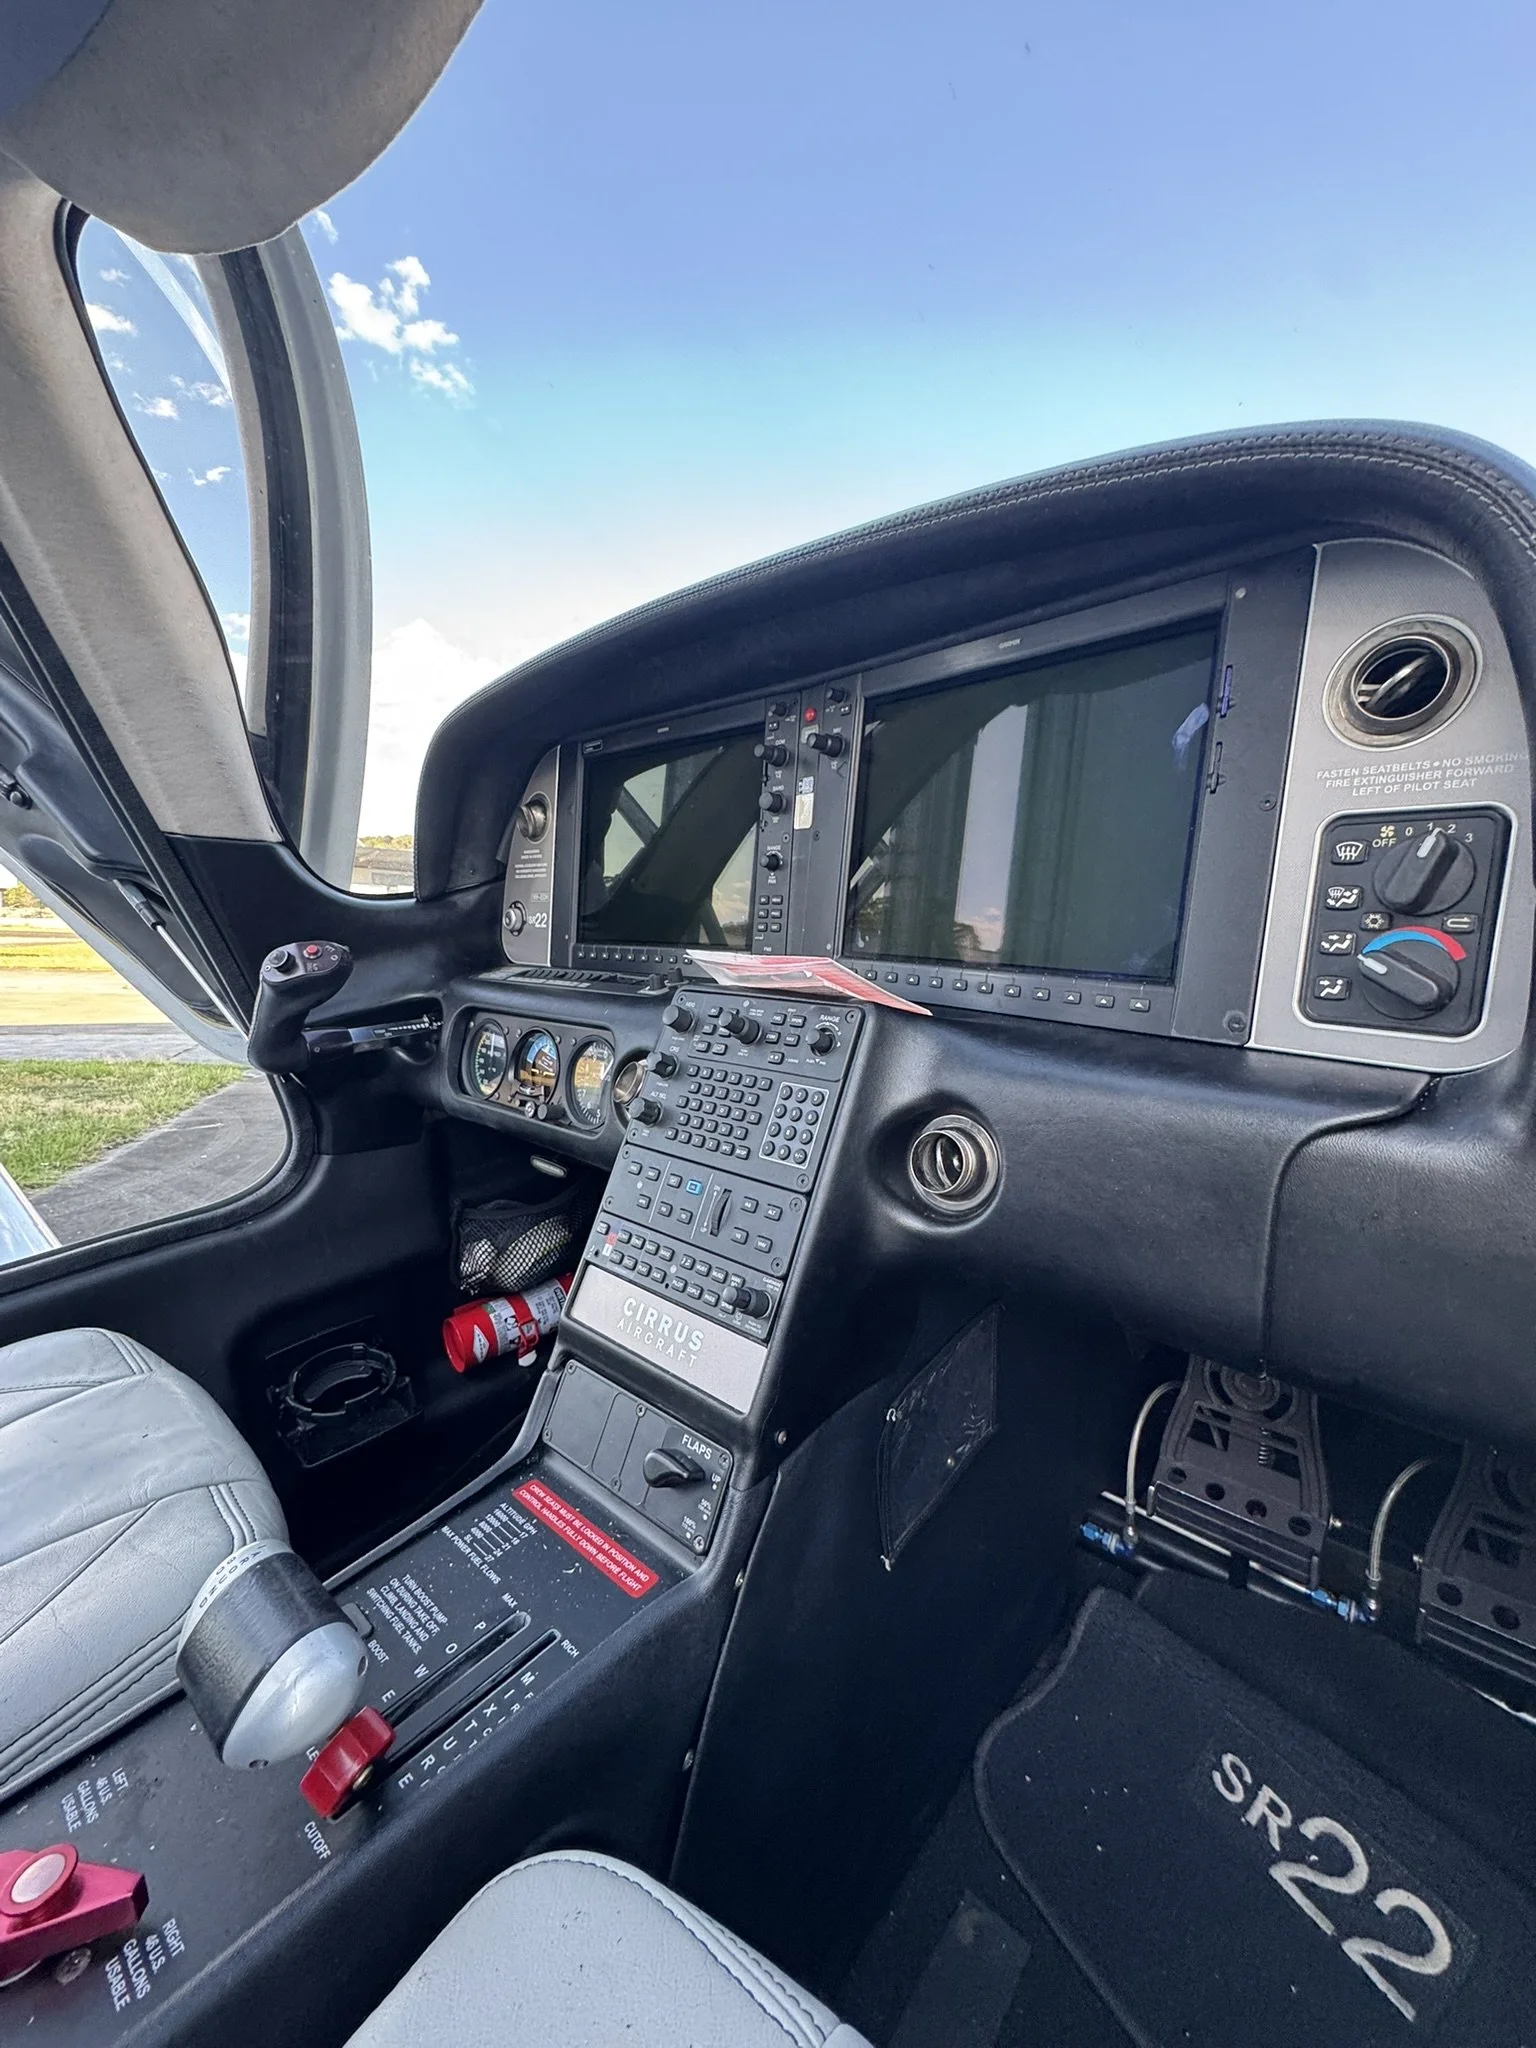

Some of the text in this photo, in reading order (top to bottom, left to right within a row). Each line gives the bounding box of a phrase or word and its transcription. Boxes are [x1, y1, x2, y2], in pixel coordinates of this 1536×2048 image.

[1316, 753, 1529, 780] FASTEN SEATBELTS NO SMOKING
[1325, 764, 1514, 788] FIRE EXTINGUISHER FORWARD
[1352, 778, 1478, 796] LEFT OF PILOT SEAT
[1372, 838, 1397, 848] OFF
[1405, 826, 1412, 836] 0
[1448, 824, 1456, 834] 2
[1464, 833, 1473, 843] 3
[819, 1014, 840, 1023] RANGE
[623, 1297, 705, 1351] CIRRUS
[617, 1318, 697, 1368] AIRCRAFT
[682, 1434, 712, 1460] FLAPS
[712, 1473, 722, 1482] UP
[485, 1513, 500, 1528] 12000
[500, 1502, 538, 1536] ALTITUDE GPH
[519, 1531, 528, 1539] 17
[529, 1484, 650, 1583] CREW SEATS MUST BE LOCKED IN POSITION AND
[441, 1525, 501, 1584] MAX POWER FUEL FLOWS
[464, 1534, 473, 1544] SL
[492, 1548, 503, 1557] 24
[501, 1542, 512, 1551] 21
[519, 1489, 642, 1592] CONTROL HANDLES FULLY DOWN BEFORE FLIGHT
[366, 1588, 394, 1620] SWITCHING
[390, 1616, 405, 1634] FUEL
[389, 1578, 440, 1636] ON DURING TAKE OFF,
[402, 1573, 448, 1624] TURN BOOST PUMP
[502, 1592, 518, 1609] MAX
[394, 1602, 419, 1629] LANDING
[413, 1627, 429, 1642] AND
[561, 1639, 580, 1658] RICH
[112, 1767, 129, 1791] LEFT
[61, 1793, 82, 1833] USABLE
[77, 1780, 99, 1824] GALLONS
[304, 1821, 332, 1860] CUTOFF
[1212, 1753, 1452, 2022] SR22
[162, 1918, 185, 1957] RIGHT
[124, 1938, 151, 2000] GALLONS
[149, 1945, 165, 1975] U.S.
[104, 1956, 132, 2012] USABLE
